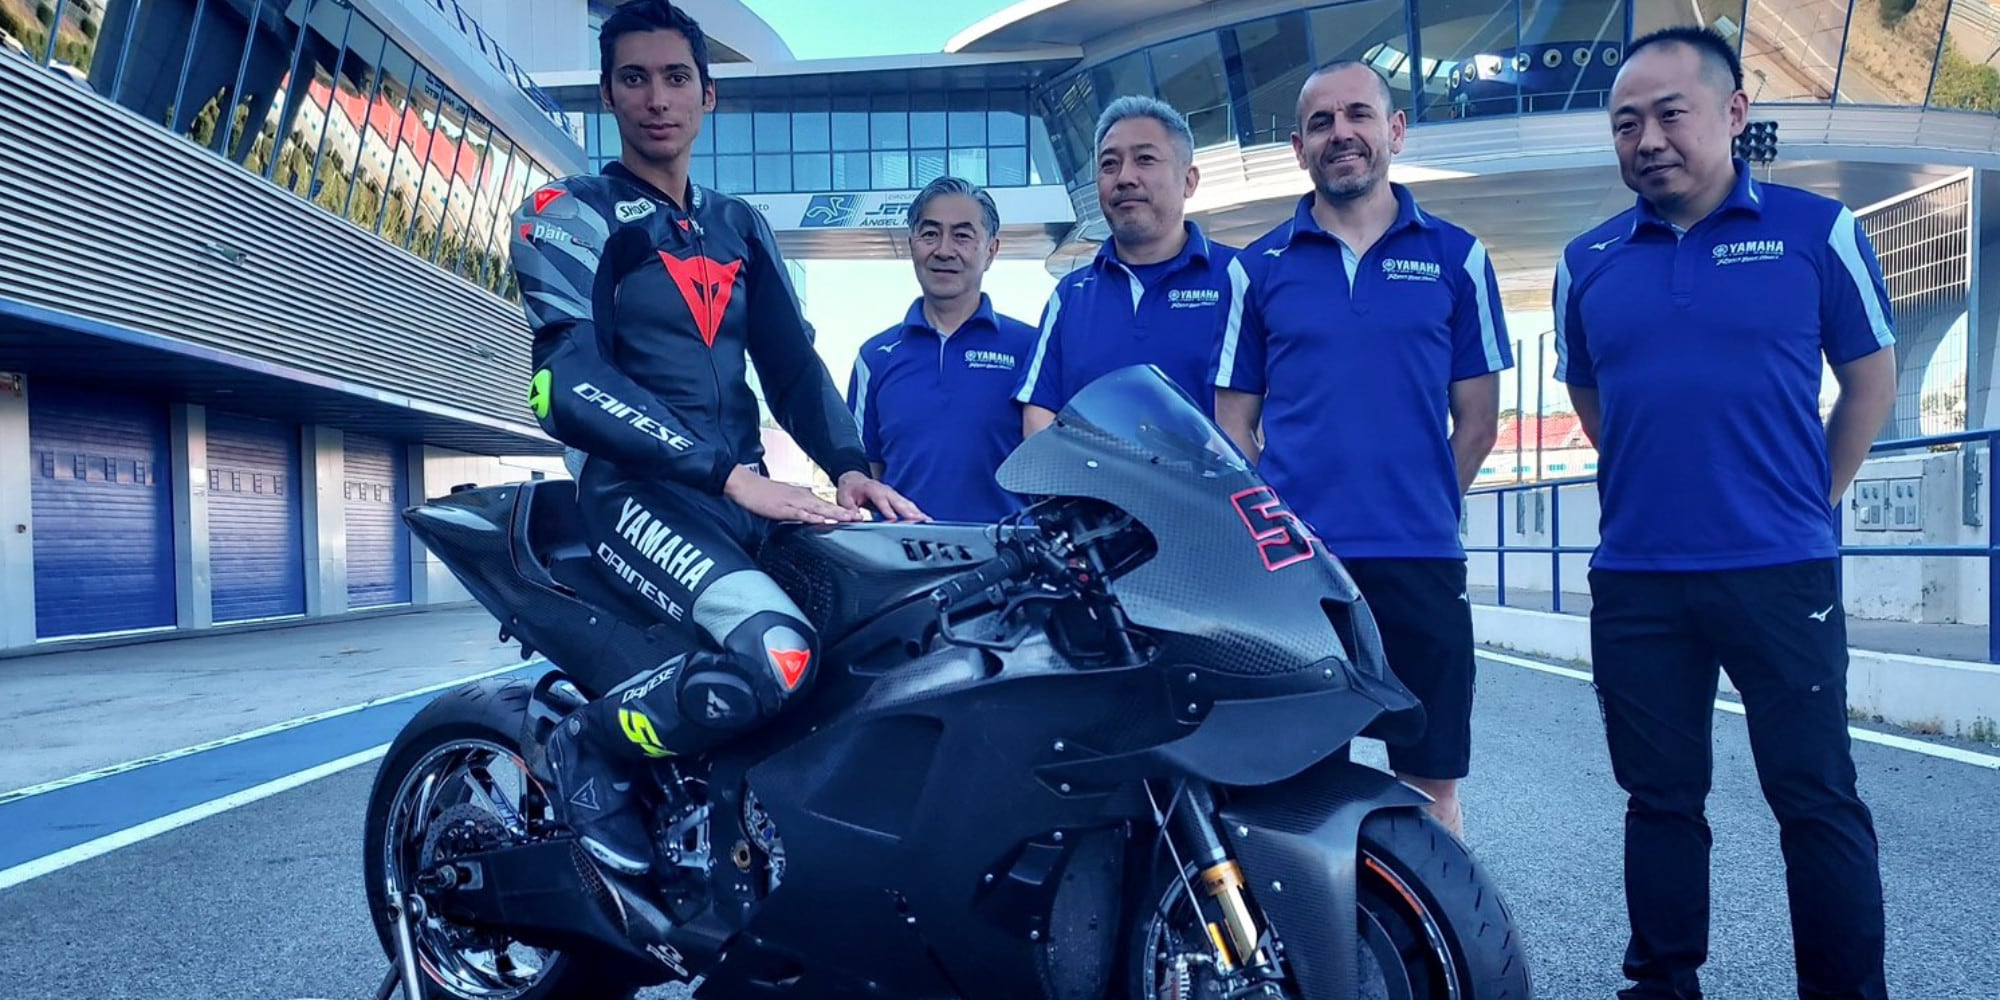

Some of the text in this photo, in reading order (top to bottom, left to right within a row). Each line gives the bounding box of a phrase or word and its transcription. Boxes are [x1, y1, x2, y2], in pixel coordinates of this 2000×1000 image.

[865, 202, 911, 215] JER
[1729, 240, 1784, 254] YAMAHA
[1396, 259, 1440, 275] YAMAHA
[1180, 289, 1219, 301] YAMAHA
[977, 350, 1015, 367] YAMAHA
[572, 382, 694, 451] DAINESE
[1230, 485, 1321, 572] 5
[615, 496, 715, 592] YAMAHA
[597, 542, 684, 622] DAINESE
[622, 666, 676, 704] DAINESE
